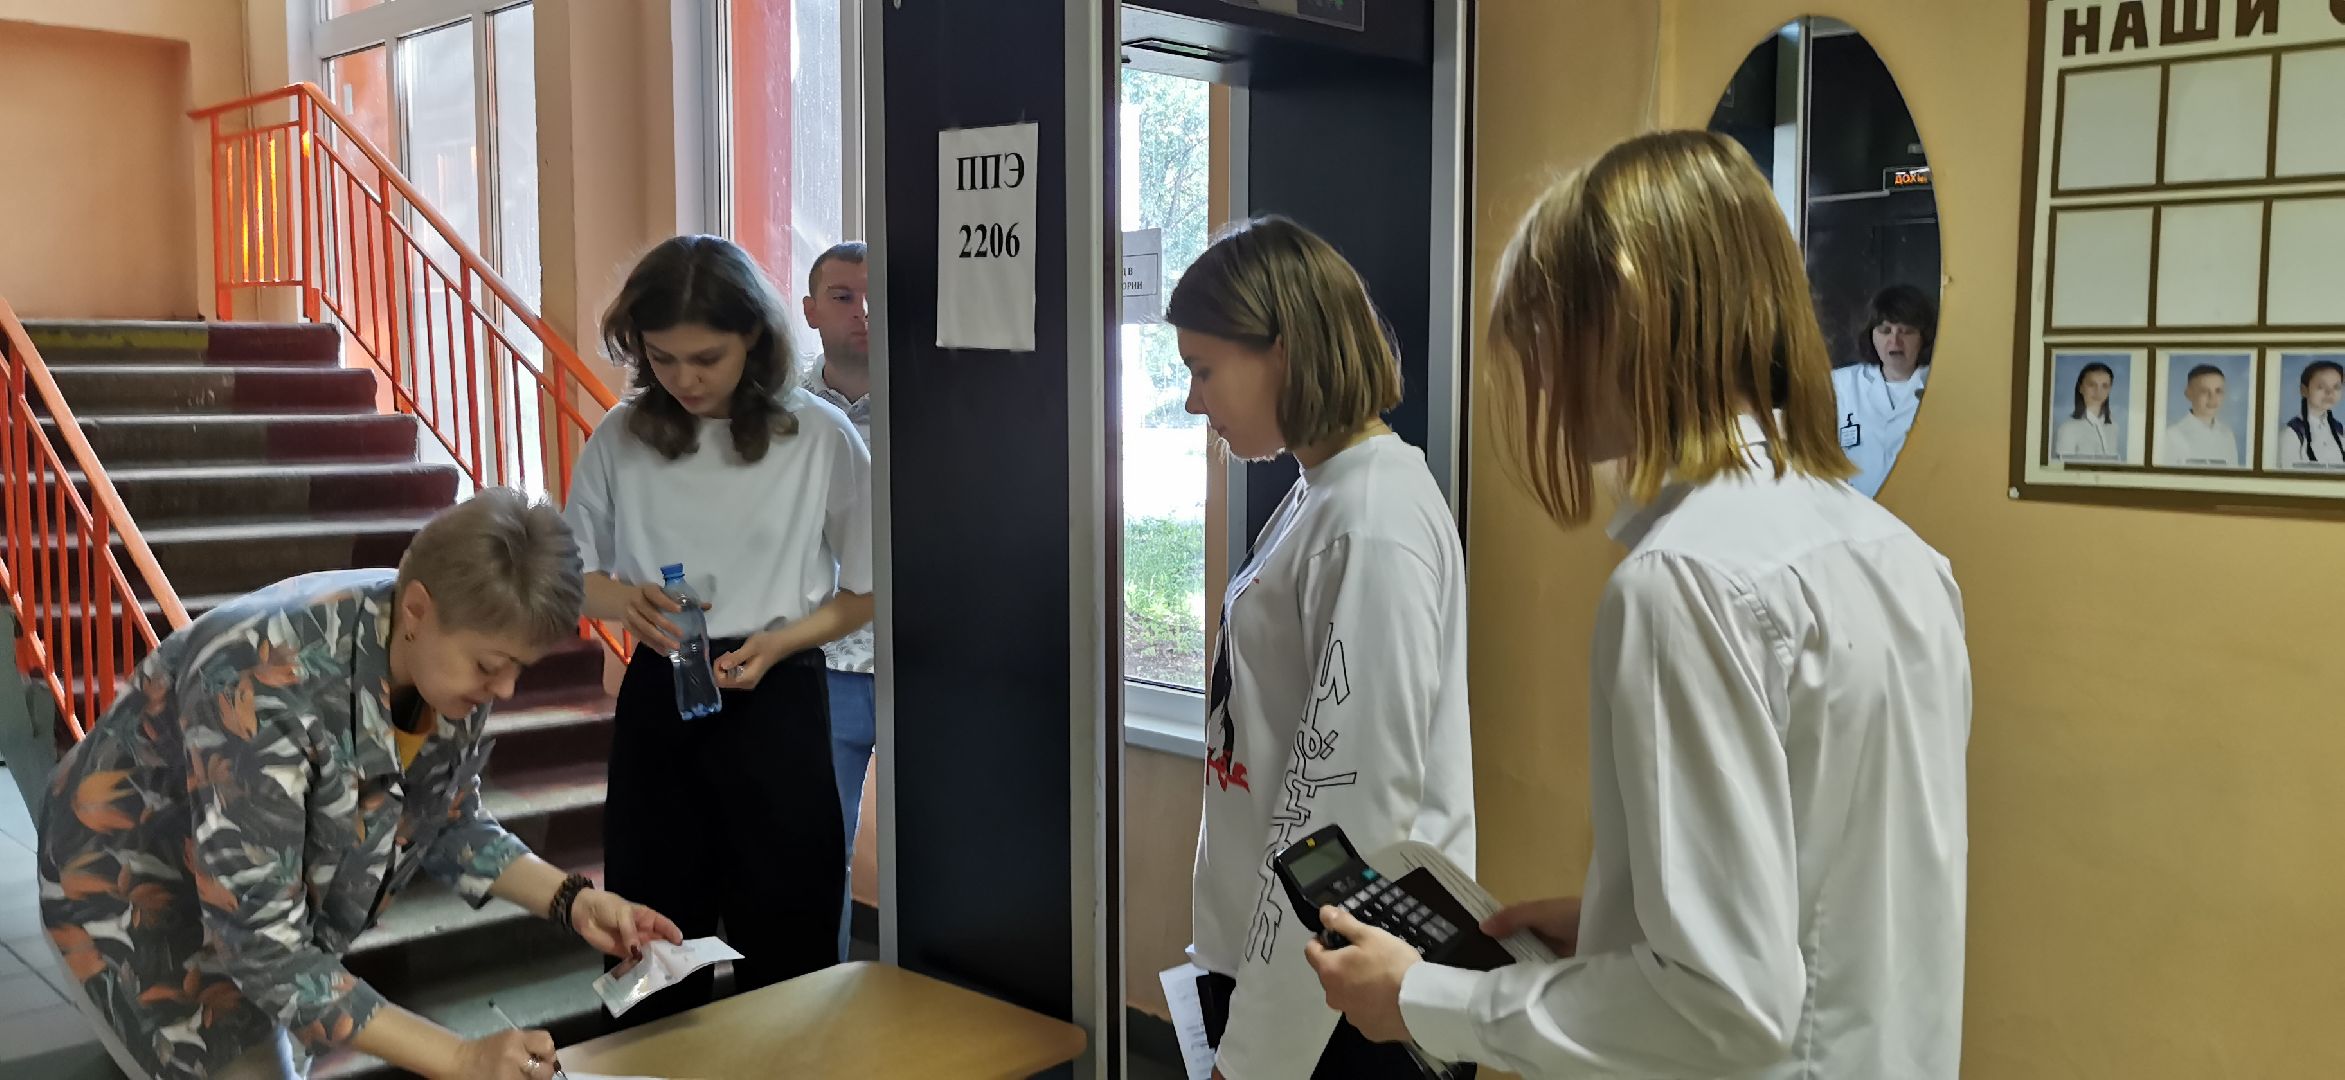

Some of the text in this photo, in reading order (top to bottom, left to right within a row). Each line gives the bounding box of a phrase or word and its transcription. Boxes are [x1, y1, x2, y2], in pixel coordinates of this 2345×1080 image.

[2062, 0, 2279, 57] НАШИ
[956, 152, 1025, 190] ППЭ
[958, 222, 1020, 258] 2206
